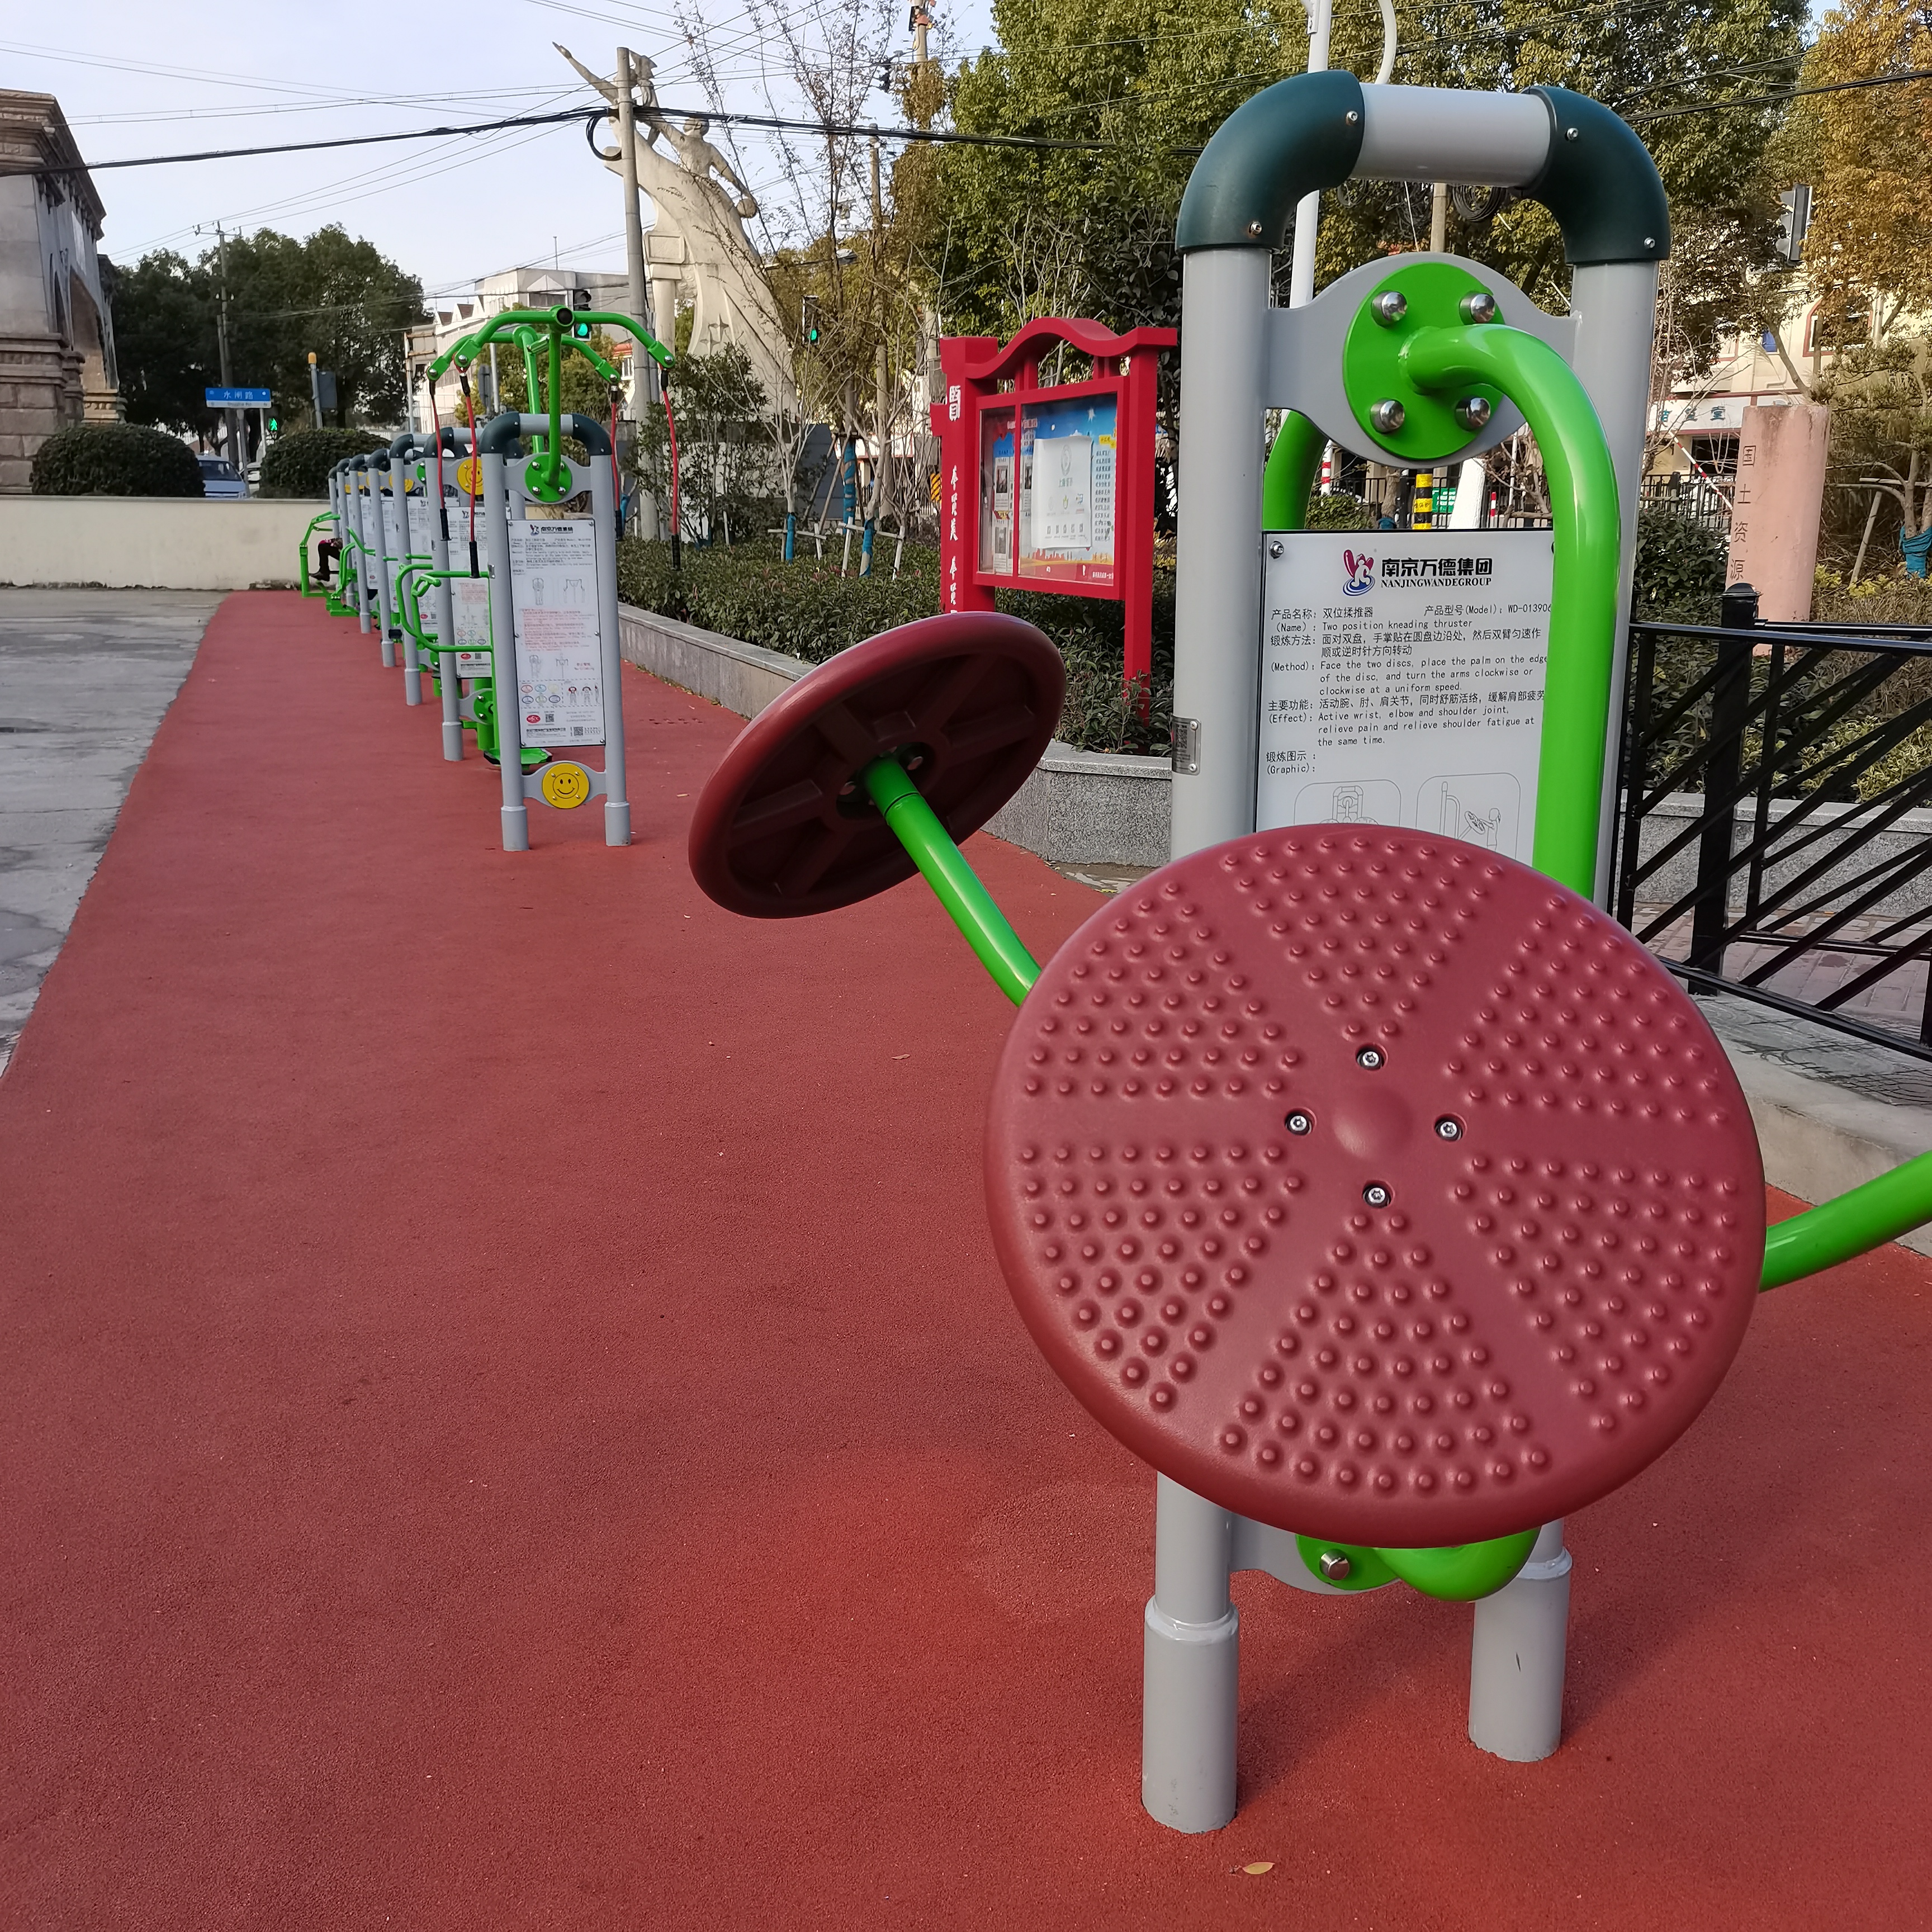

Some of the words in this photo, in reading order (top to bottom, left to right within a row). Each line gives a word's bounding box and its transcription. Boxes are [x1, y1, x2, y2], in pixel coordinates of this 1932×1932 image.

[1730, 445, 1756, 581] 国土资源
[1382, 557, 1493, 577] 南京万德集团
[1381, 577, 1492, 588] NANJINGWANDEGROUP
[1323, 607, 1373, 619] 双位揉推器
[1323, 622, 1337, 631] Two
[1343, 621, 1383, 632] position
[1389, 619, 1428, 629] kneading
[1434, 619, 1472, 628] thruster
[1321, 661, 1341, 669] Face
[1346, 660, 1361, 669] the
[1422, 657, 1446, 668] place
[1451, 656, 1465, 665] the
[1471, 656, 1490, 666] palm
[1510, 655, 1524, 664] the
[1320, 674, 1330, 683] of
[1336, 673, 1350, 682] the
[1386, 671, 1400, 680] and
[1431, 670, 1445, 679] the
[1475, 667, 1518, 677] clockwise
[1320, 685, 1365, 695] clockwise
[1395, 683, 1430, 693] uniform
[1318, 712, 1348, 721] Active
[1389, 709, 1414, 718] elbow
[1419, 708, 1433, 716] and
[1439, 706, 1477, 716] shoulder
[1319, 724, 1353, 733] relieve
[1358, 723, 1378, 733] pain
[1384, 722, 1398, 731] and
[1404, 721, 1437, 730] relieve
[1443, 718, 1481, 728] shoulder
[1488, 717, 1520, 727] fatigue
[1525, 716, 1534, 724] at
[1318, 737, 1332, 746] the
